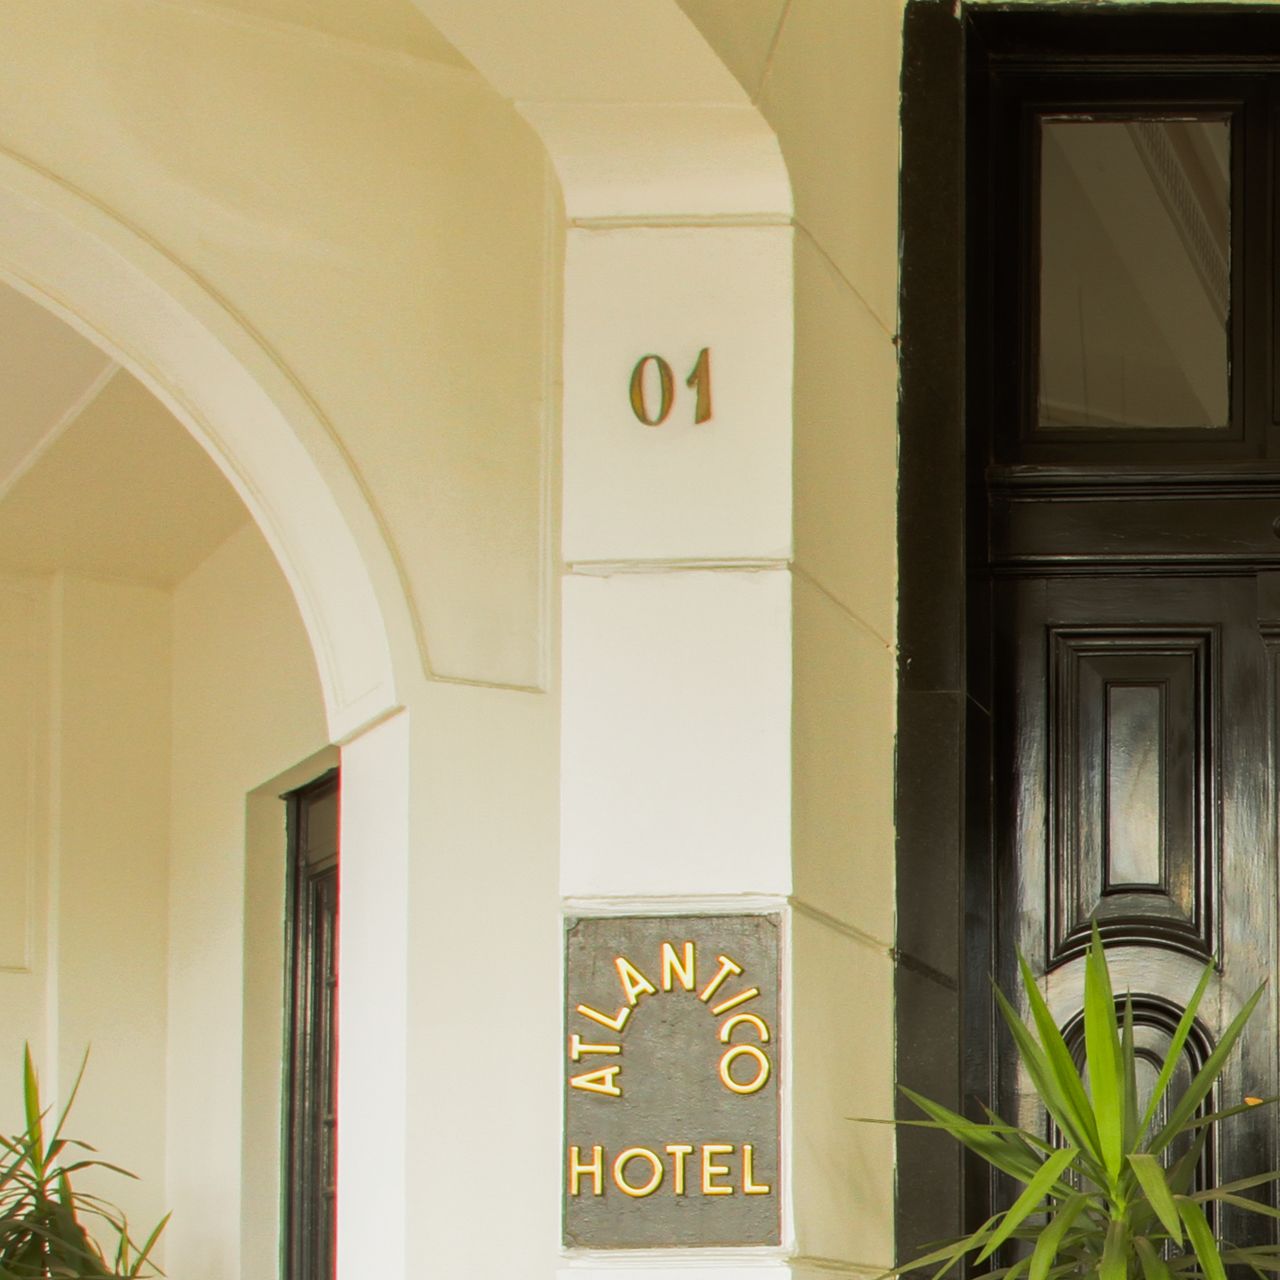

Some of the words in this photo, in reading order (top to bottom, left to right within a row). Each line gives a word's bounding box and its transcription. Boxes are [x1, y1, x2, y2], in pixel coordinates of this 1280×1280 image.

[629, 346, 712, 427] 01
[570, 940, 771, 1098] ATLANTICO
[570, 1143, 771, 1198] HOTEL
